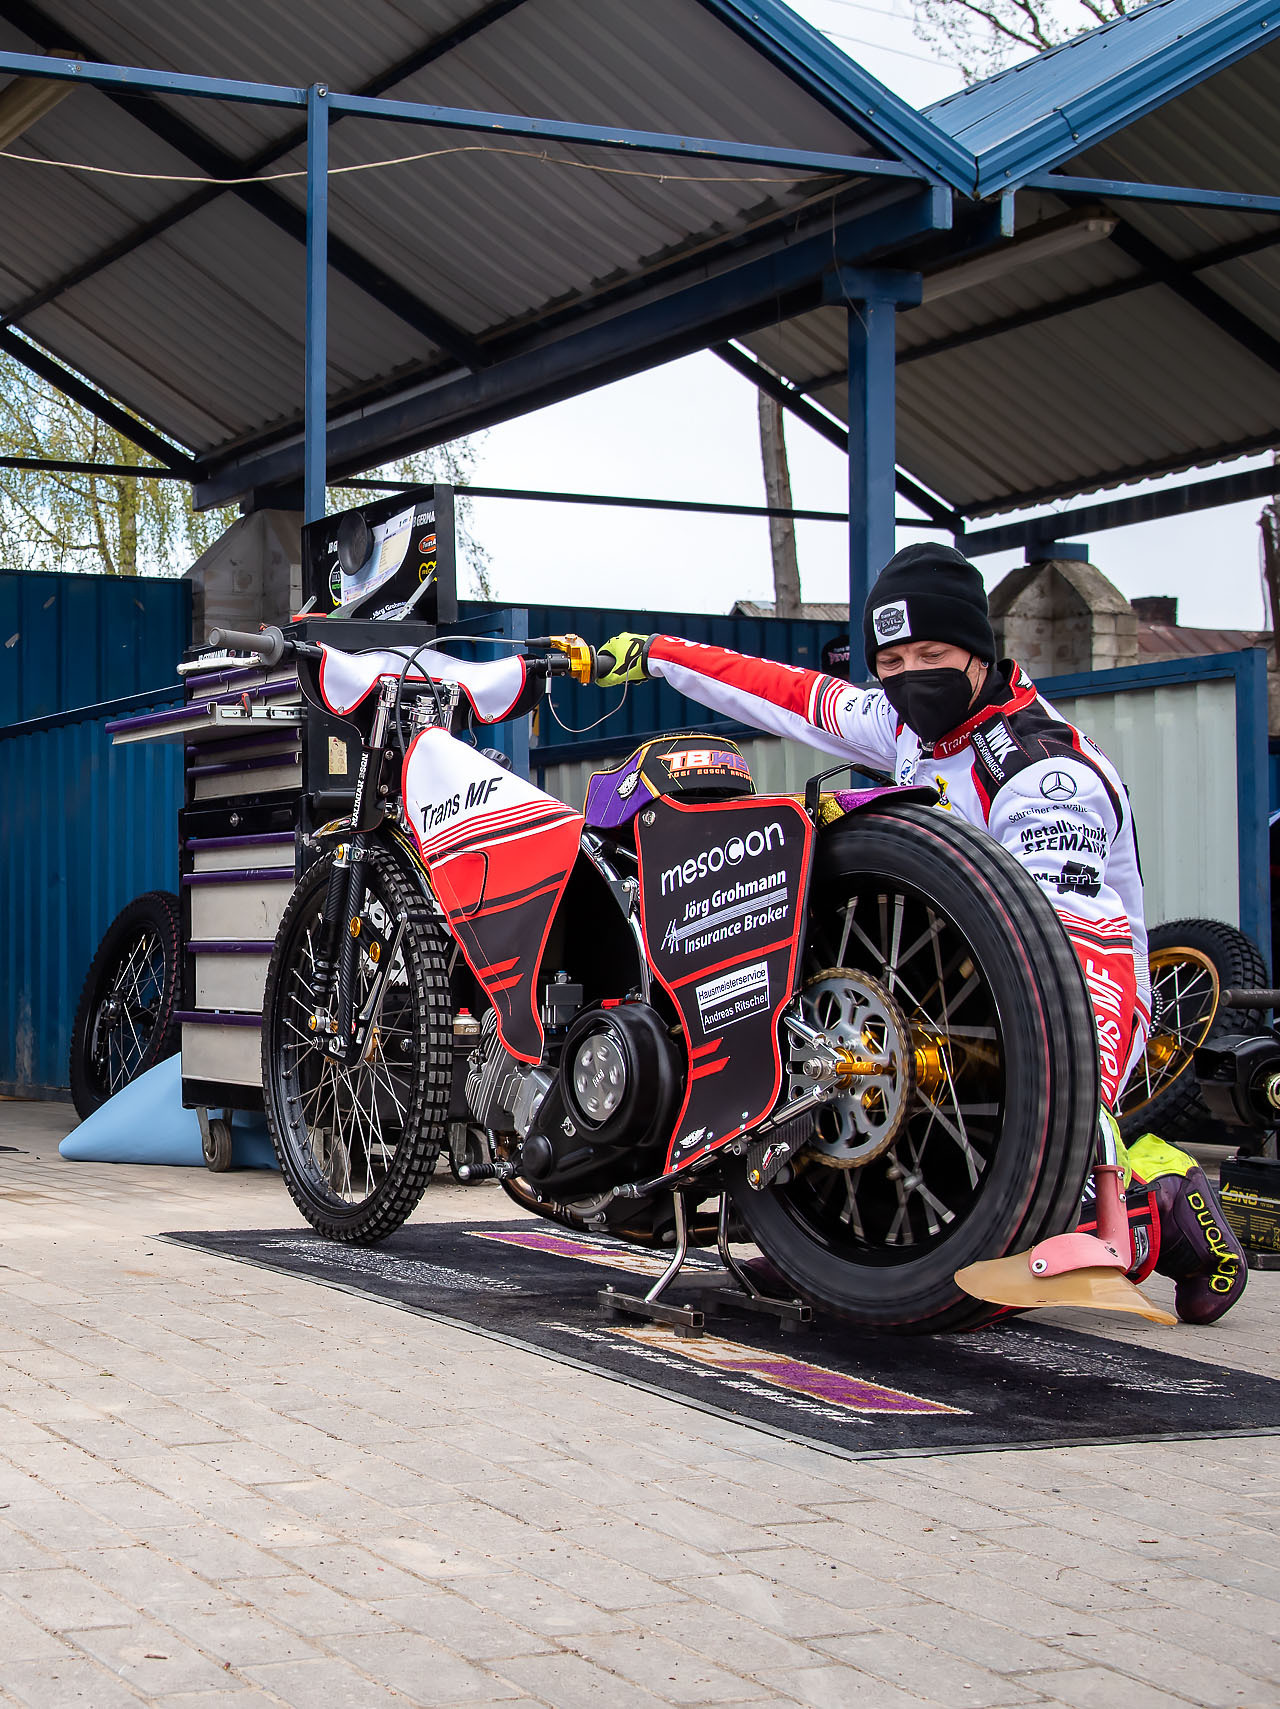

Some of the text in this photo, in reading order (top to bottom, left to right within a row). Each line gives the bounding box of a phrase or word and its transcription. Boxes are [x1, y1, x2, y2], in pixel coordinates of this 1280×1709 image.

[985, 721, 1019, 765] WWK
[667, 770, 691, 779] TOBI
[420, 776, 503, 833] Trans MF
[683, 870, 786, 921] Jörg Grohmann
[684, 905, 789, 954] Insurance Broker
[698, 969, 766, 1001] Hausmeisterservice
[704, 991, 767, 1026] Andreas Ritschel
[1085, 958, 1124, 1018] MF
[1187, 1191, 1240, 1293] daytona
